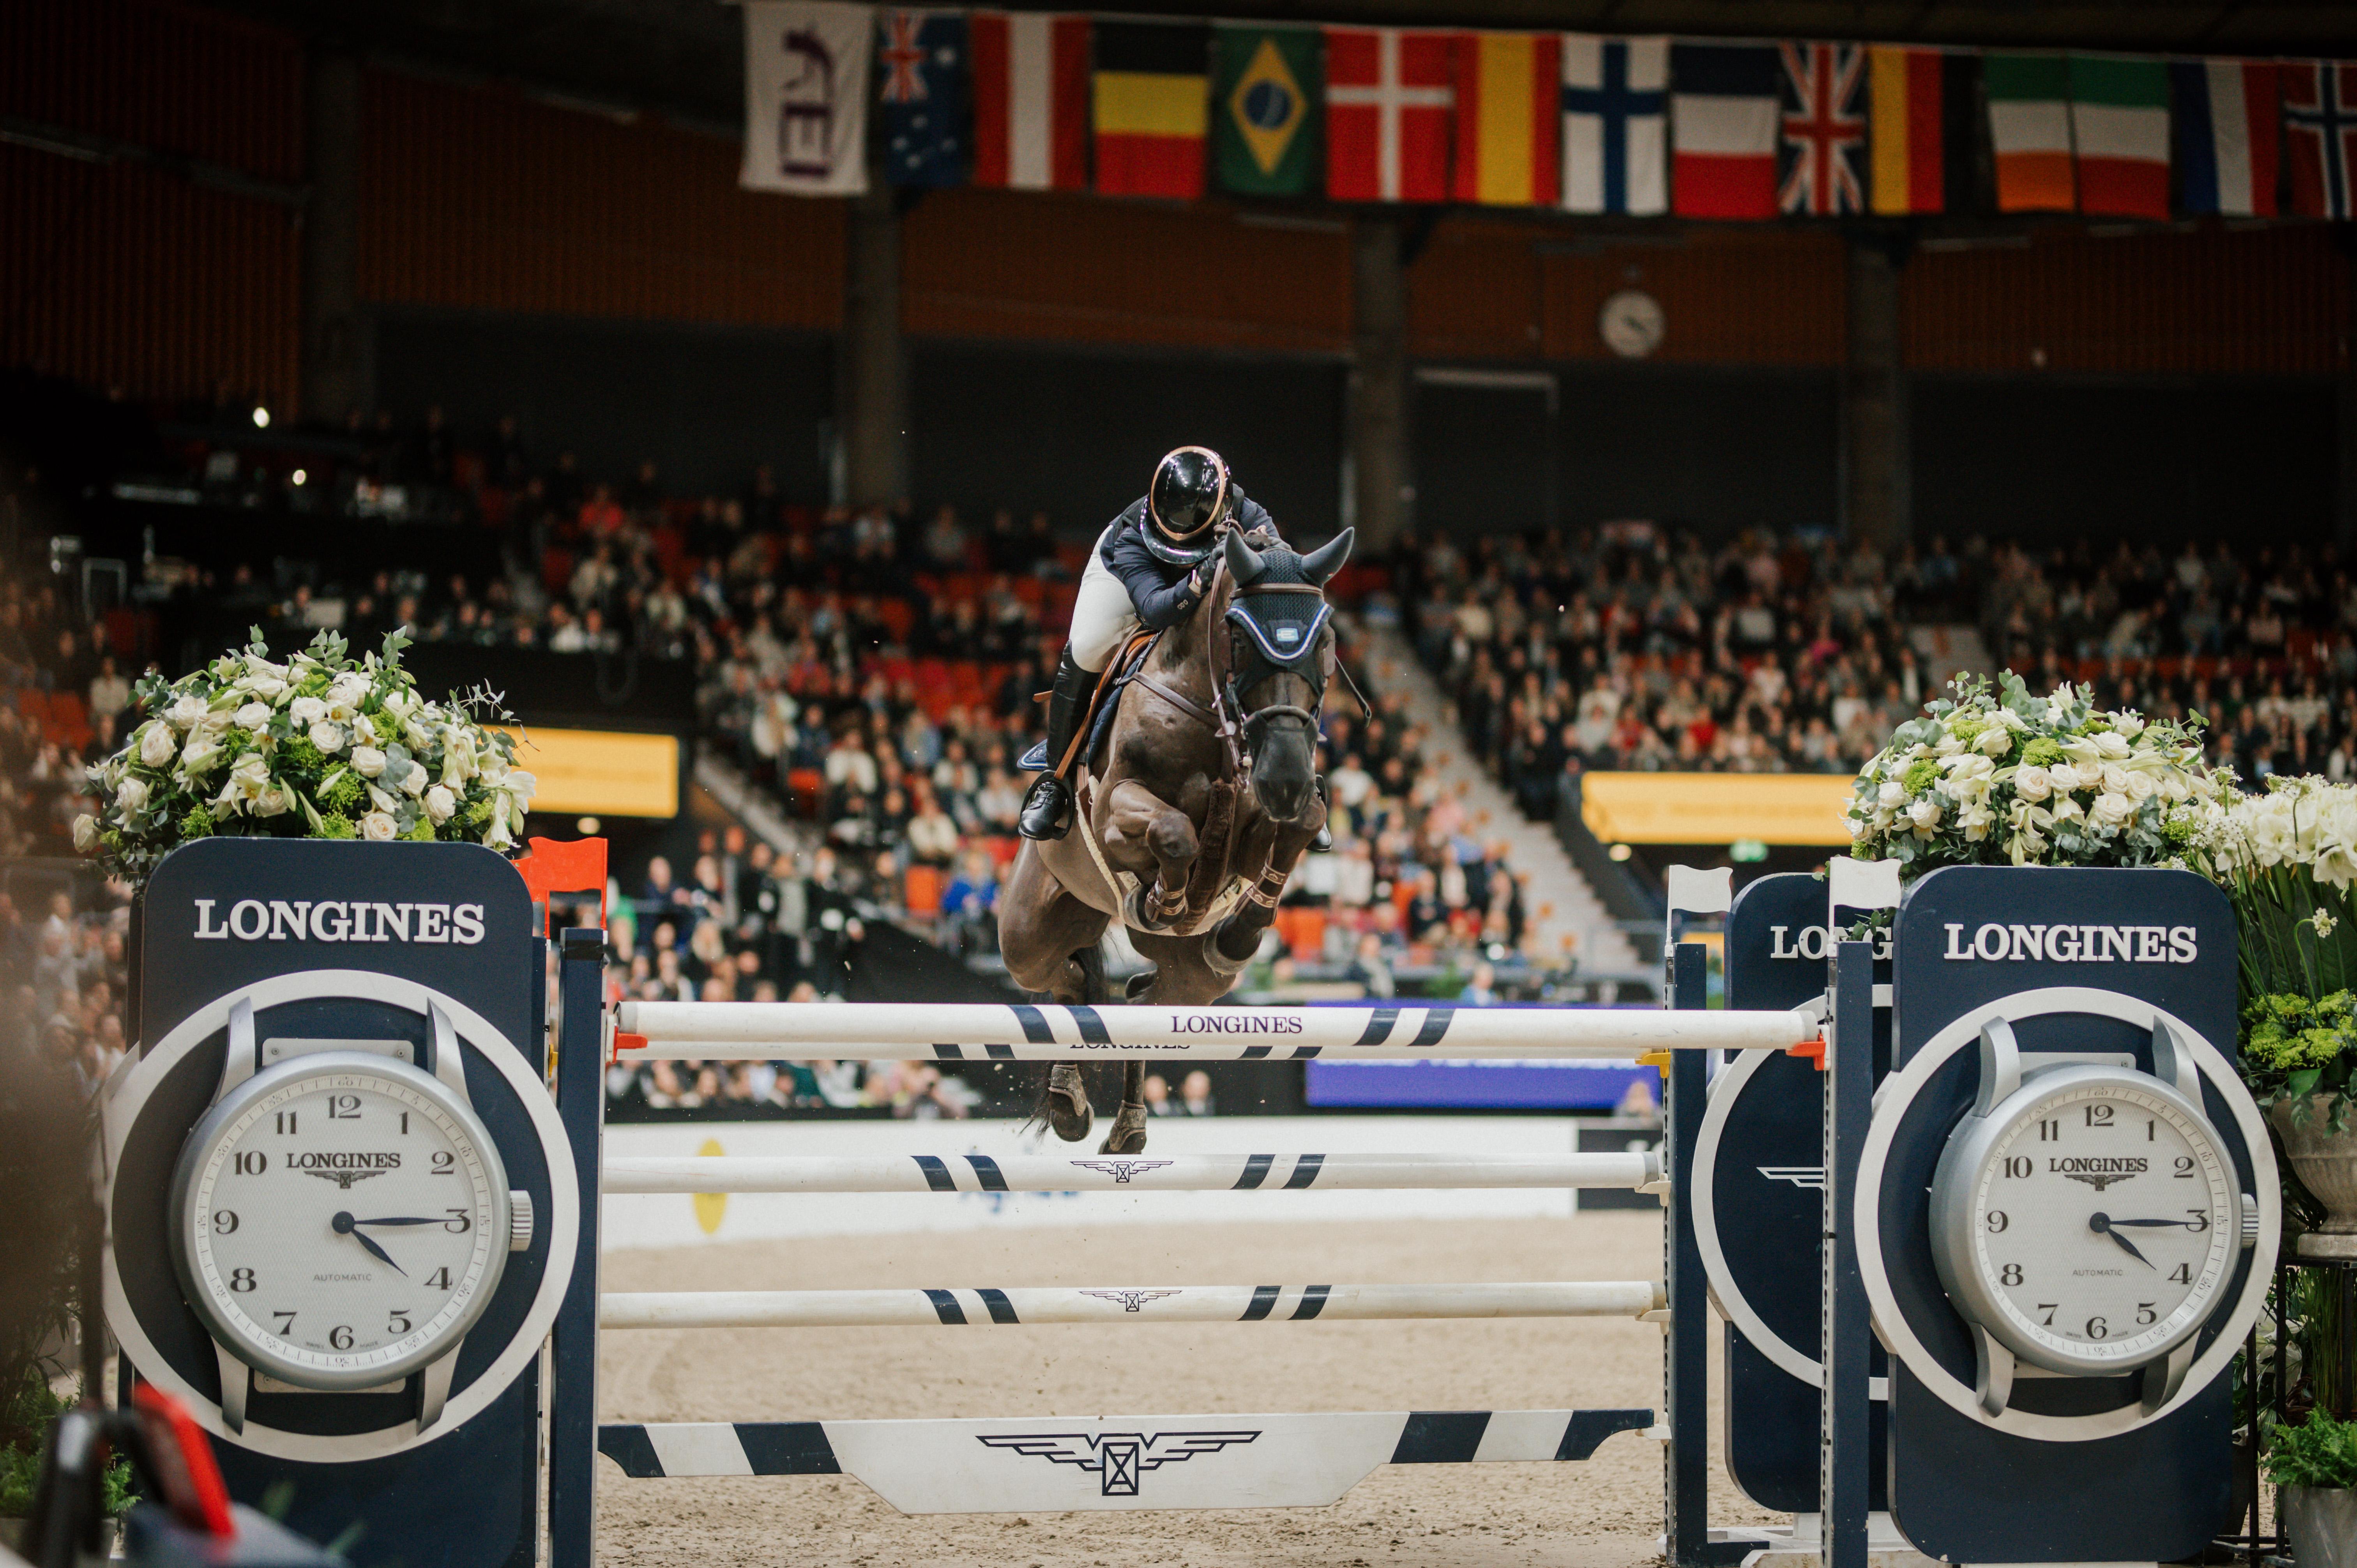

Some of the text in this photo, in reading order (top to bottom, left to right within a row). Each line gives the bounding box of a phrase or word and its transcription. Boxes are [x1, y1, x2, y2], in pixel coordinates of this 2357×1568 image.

[194, 898, 486, 945] LONGINES
[1770, 925, 1894, 960] LOG
[1944, 923, 2198, 963] LONGINES
[1171, 1016, 1302, 1033] LONGINES
[327, 1095, 361, 1119] 12
[2084, 1105, 2114, 1127] 12
[274, 1111, 297, 1134] 11
[399, 1112, 408, 1134] 1
[2039, 1119, 2058, 1141] 11
[2146, 1120, 2155, 1141] 1
[218, 1145, 229, 1159] 50
[233, 1151, 267, 1175] 10
[286, 1153, 401, 1168] LONGINES
[431, 1151, 454, 1175] 2
[460, 1147, 470, 1157] 10
[2200, 1152, 2210, 1162] 10
[2004, 1156, 2033, 1178] 10
[2050, 1158, 2148, 1172] LONGINES
[2174, 1157, 2194, 1178] 2
[214, 1210, 239, 1234] 9
[445, 1209, 470, 1234] 3
[480, 1215, 486, 1226] 15
[1987, 1211, 2008, 1233] 9
[2185, 1210, 2208, 1232] 3
[2217, 1216, 2224, 1225] 15
[230, 1268, 256, 1292] 8
[423, 1267, 452, 1290] 4
[2001, 1264, 2023, 1286] 8
[2167, 1263, 2193, 1284] 4
[2198, 1277, 2210, 1290] 20
[458, 1283, 470, 1298] 20
[274, 1312, 297, 1335] 7
[388, 1309, 411, 1334] 5
[2038, 1303, 2059, 1325] 7
[2136, 1301, 2156, 1324] 5
[329, 1326, 354, 1350] 6
[2086, 1317, 2108, 1339] 6
[405, 1335, 419, 1347] 25
